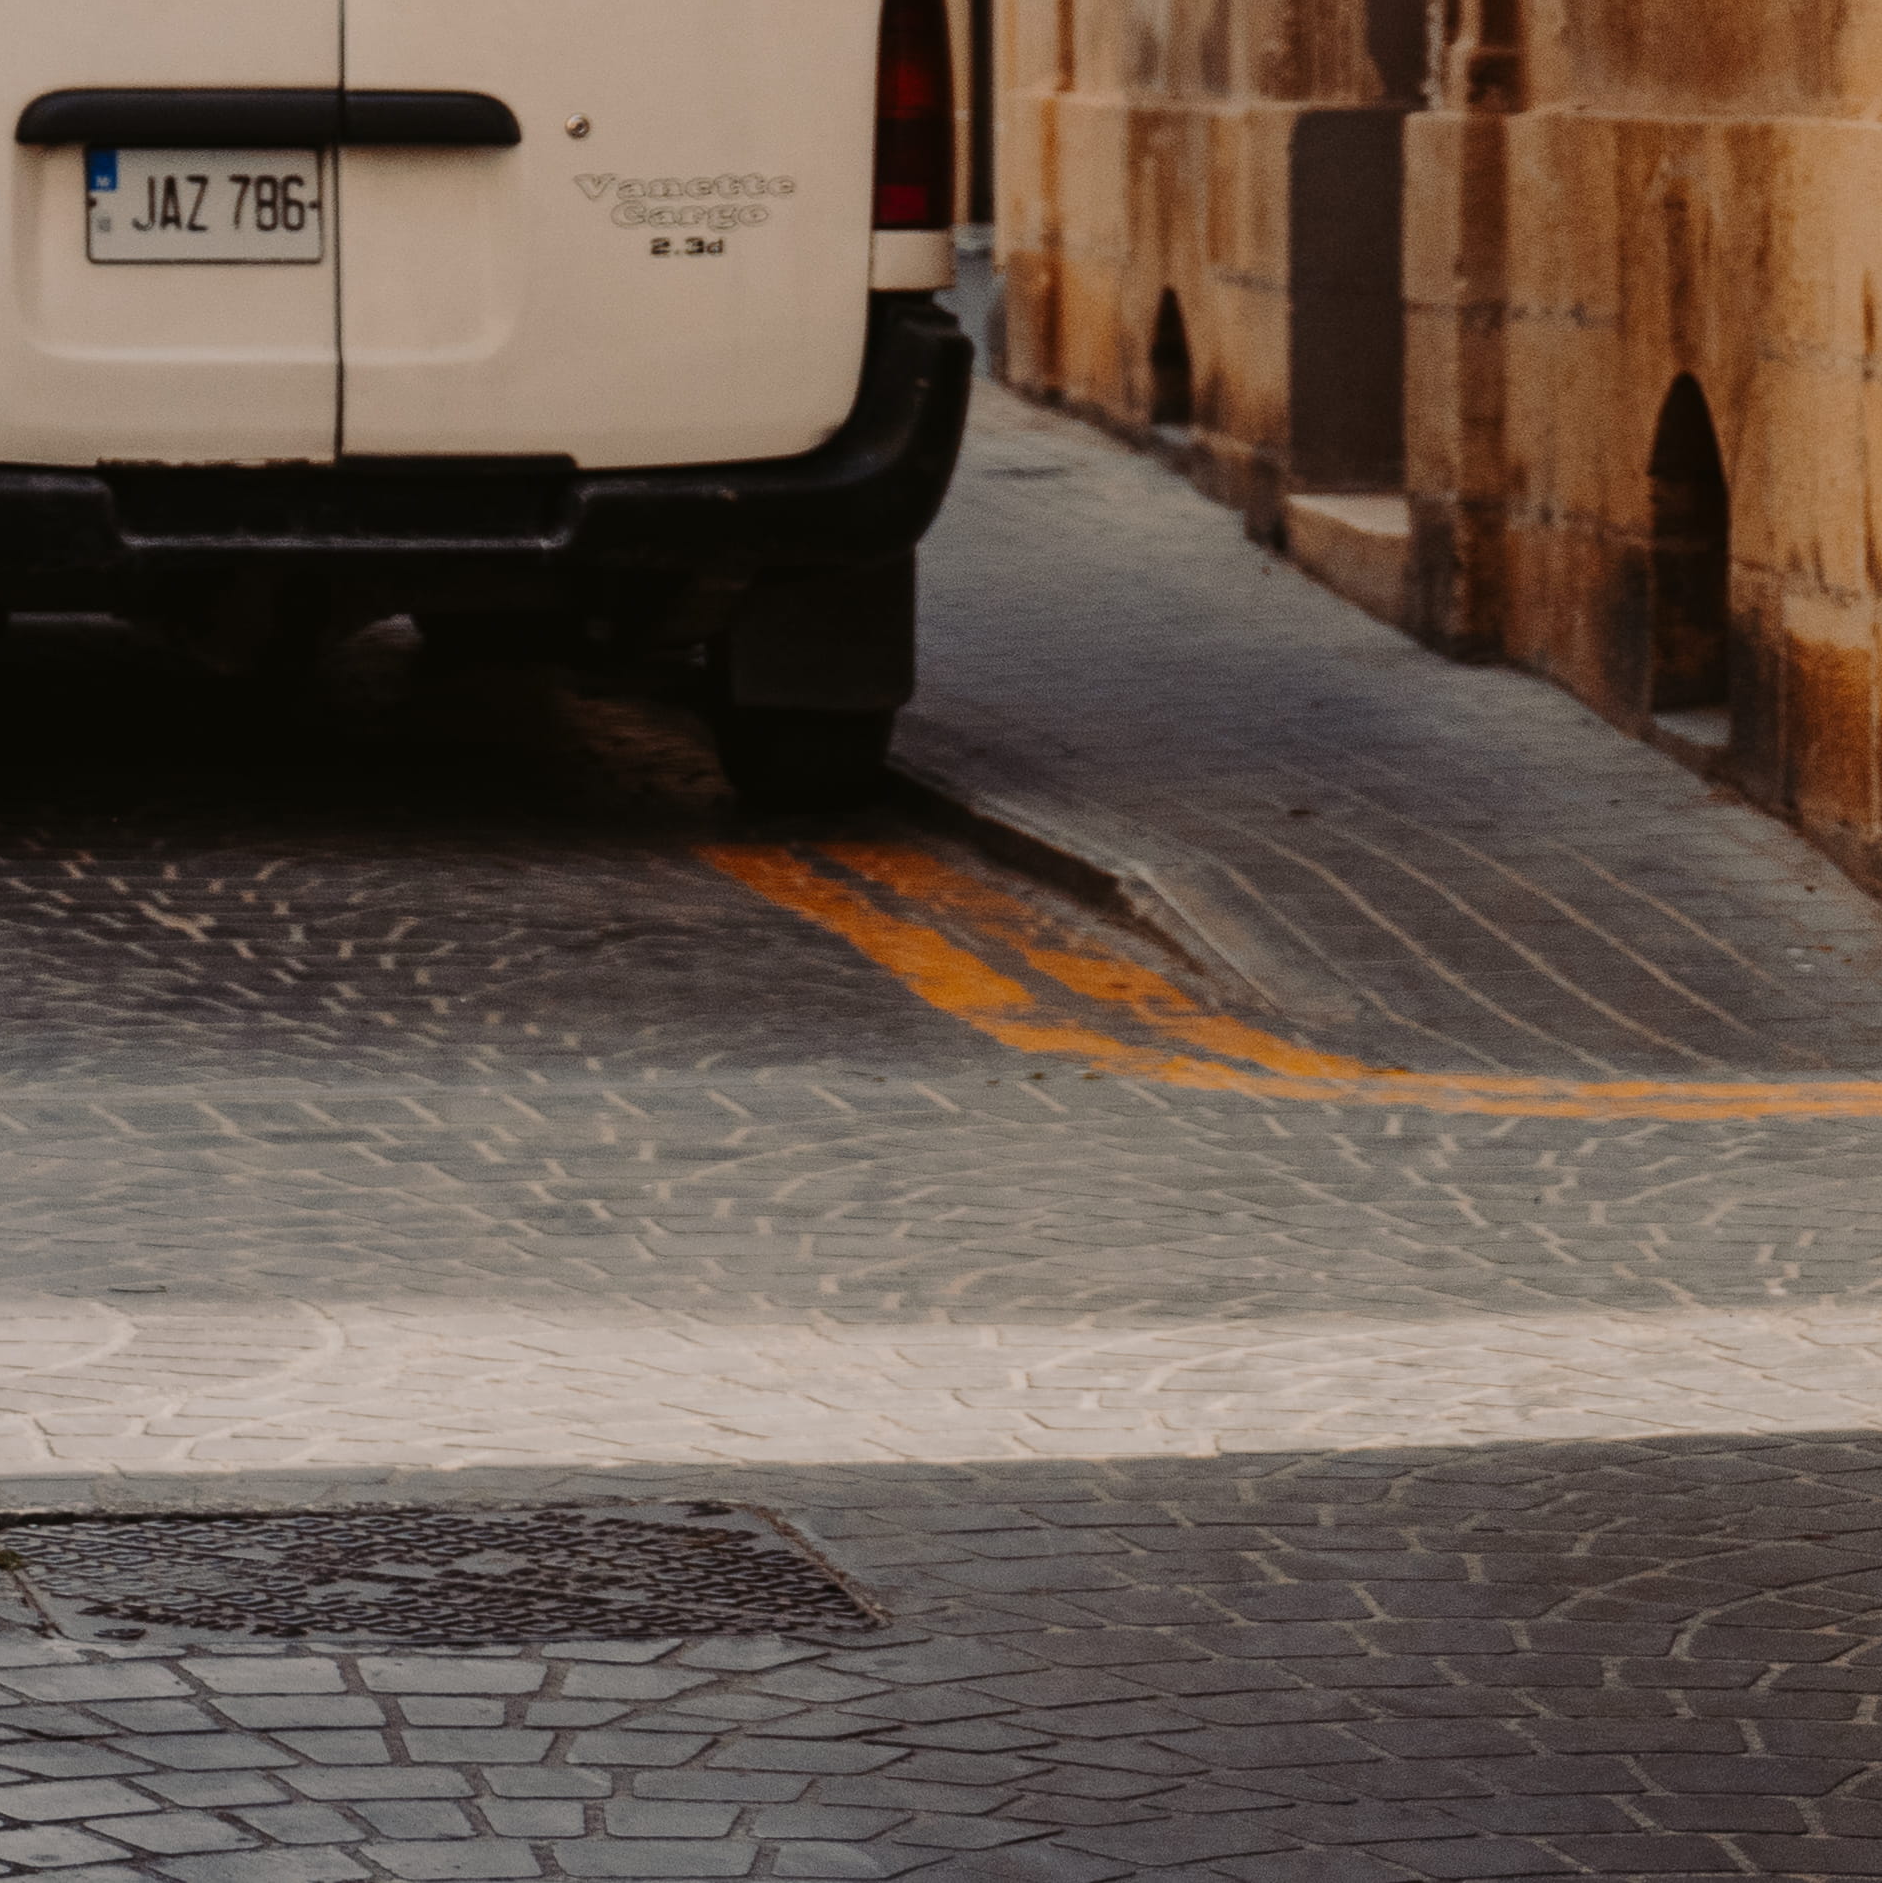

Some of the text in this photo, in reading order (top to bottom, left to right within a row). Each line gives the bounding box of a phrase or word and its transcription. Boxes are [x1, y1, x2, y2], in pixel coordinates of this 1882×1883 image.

[132, 173, 306, 232] JAZ 786
[572, 172, 797, 202] Vanette
[610, 199, 770, 233] Cargo
[649, 236, 725, 257] 2.3d
